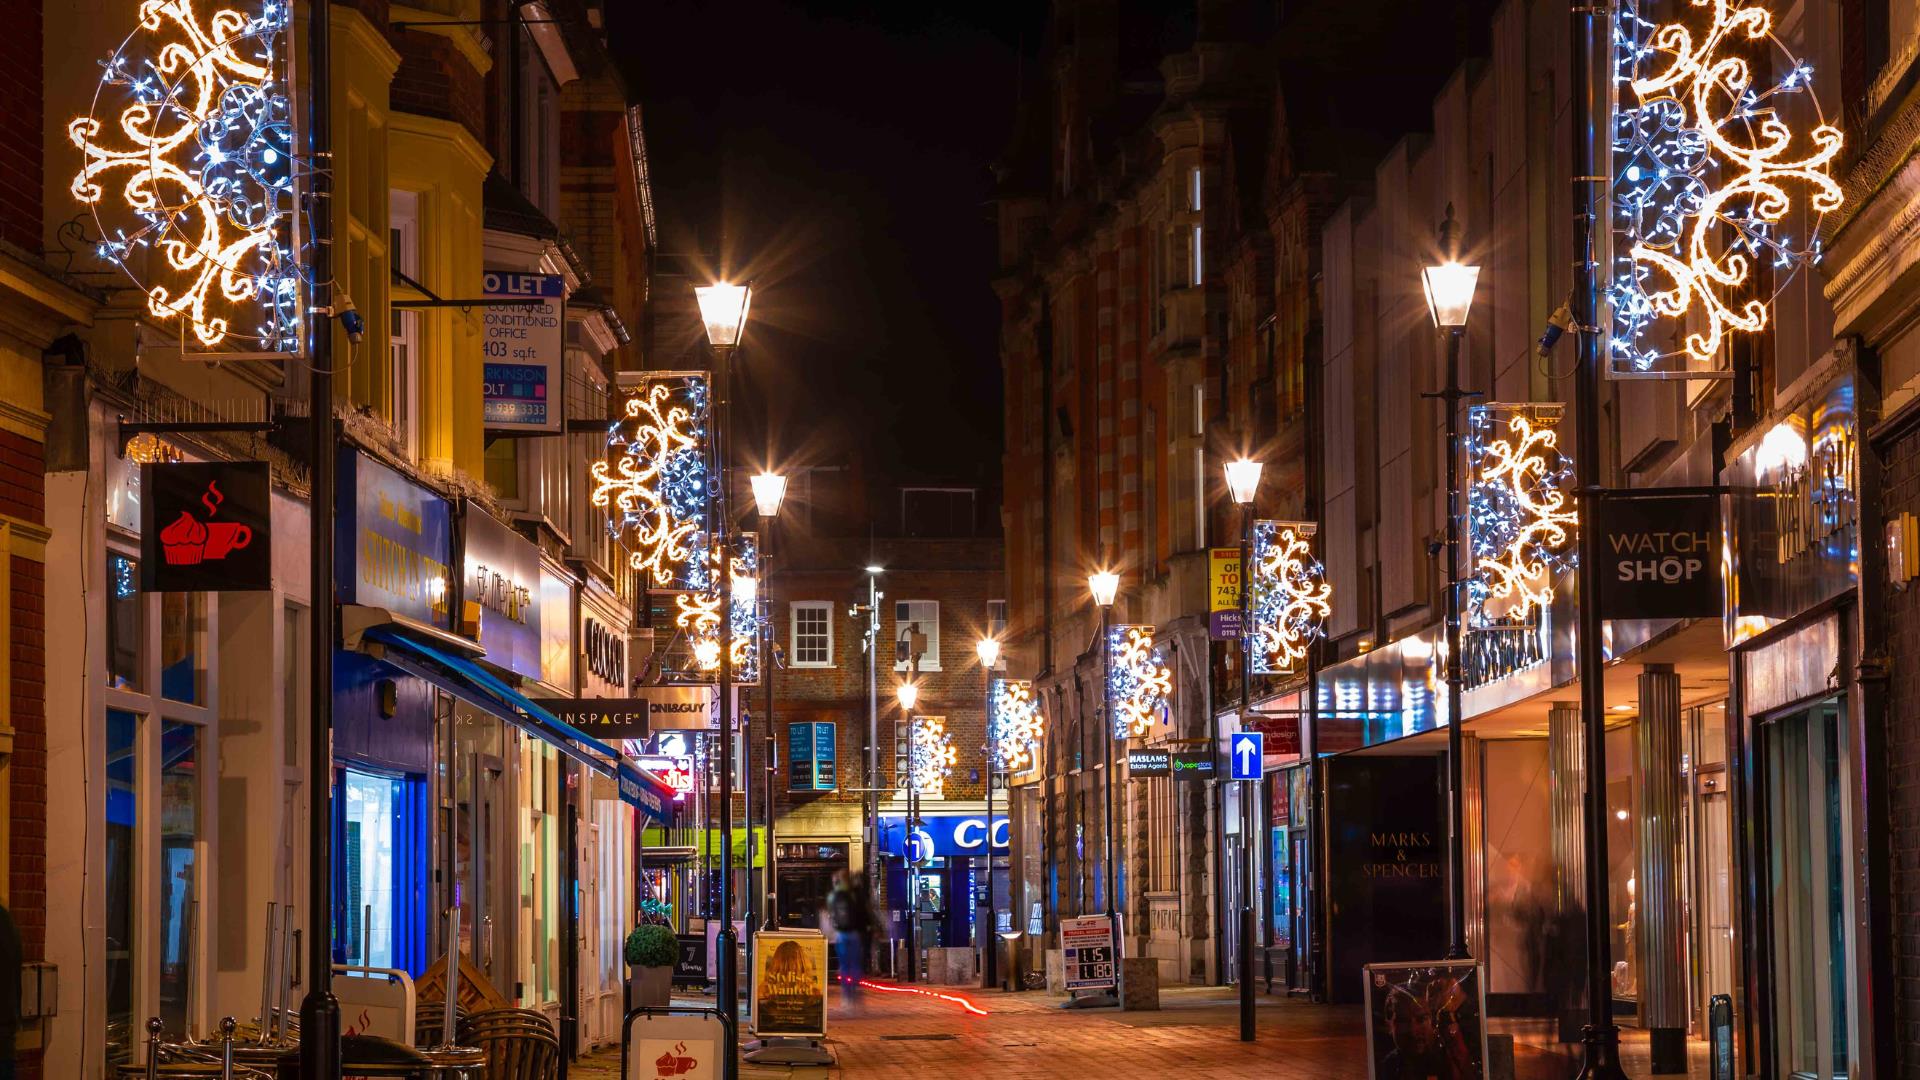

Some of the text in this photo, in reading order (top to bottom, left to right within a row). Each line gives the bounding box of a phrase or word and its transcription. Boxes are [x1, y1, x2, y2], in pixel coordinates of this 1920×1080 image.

[484, 274, 546, 295] O LET
[489, 327, 527, 339] OFFICE
[513, 347, 536, 360] sq.ft
[485, 367, 546, 382] RKINSON
[483, 383, 505, 396] OLT
[1609, 532, 1711, 555] WATCH
[363, 527, 406, 597] STITCH
[1618, 556, 1702, 584] SHOP
[1220, 573, 1239, 585] TO
[1217, 587, 1236, 595] 743
[650, 703, 705, 713] ONI&GUY
[1129, 755, 1168, 763] HASLAMS
[1371, 832, 1431, 847] MARKS
[1396, 849, 1407, 862] &
[1362, 863, 1440, 878] SPENCER
[686, 946, 697, 962] 7
[768, 970, 813, 983] Stylists
[767, 983, 813, 995] Wanted
